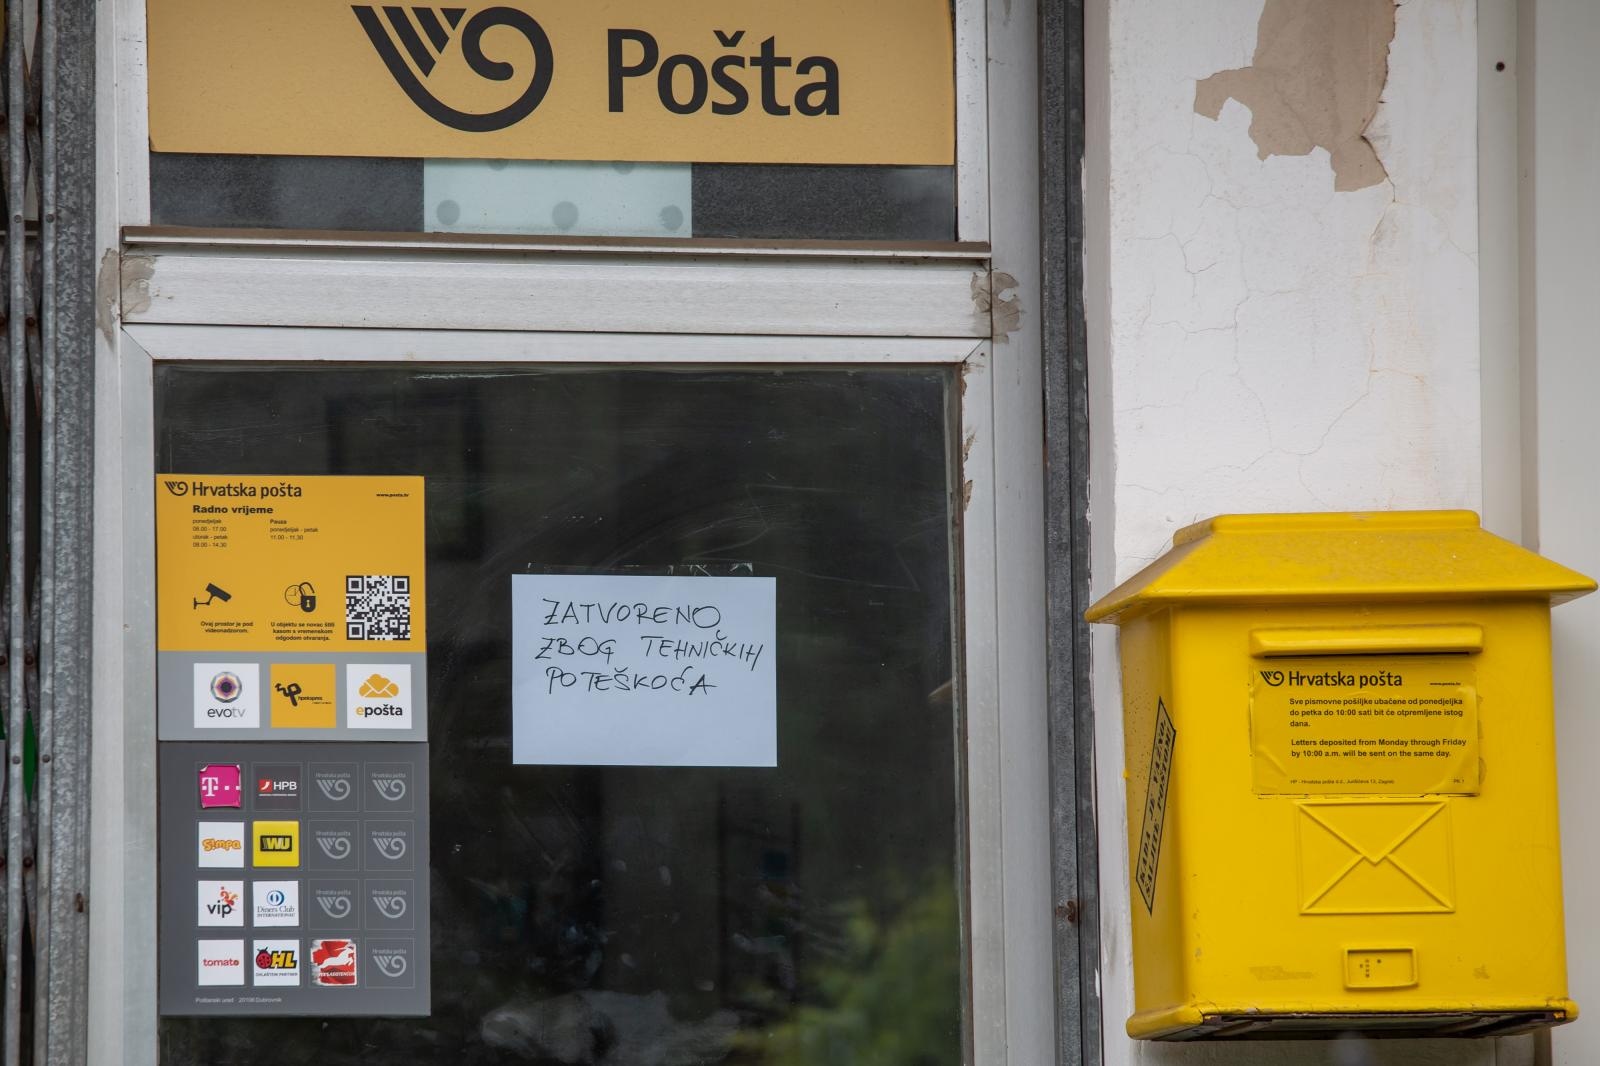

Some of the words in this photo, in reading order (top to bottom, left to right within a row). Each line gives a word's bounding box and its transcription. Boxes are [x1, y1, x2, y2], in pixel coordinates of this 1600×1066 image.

[607, 28, 839, 116] Pošta
[192, 482, 256, 496] Hrvatska
[260, 482, 302, 499] pošta
[192, 505, 228, 513] Radno
[232, 506, 273, 515] vrijeme
[542, 598, 721, 629] ZATVORENO
[534, 636, 617, 664] ZBOG
[640, 630, 763, 671] TEHNIČKIH
[1289, 671, 1355, 686] Hrvatska
[1360, 671, 1402, 689] pošta
[207, 707, 245, 718] evotv
[356, 704, 403, 717] epošta
[273, 781, 297, 790] HPB
[263, 838, 290, 850] WU
[207, 900, 232, 918] vip
[203, 958, 240, 967] tomato
